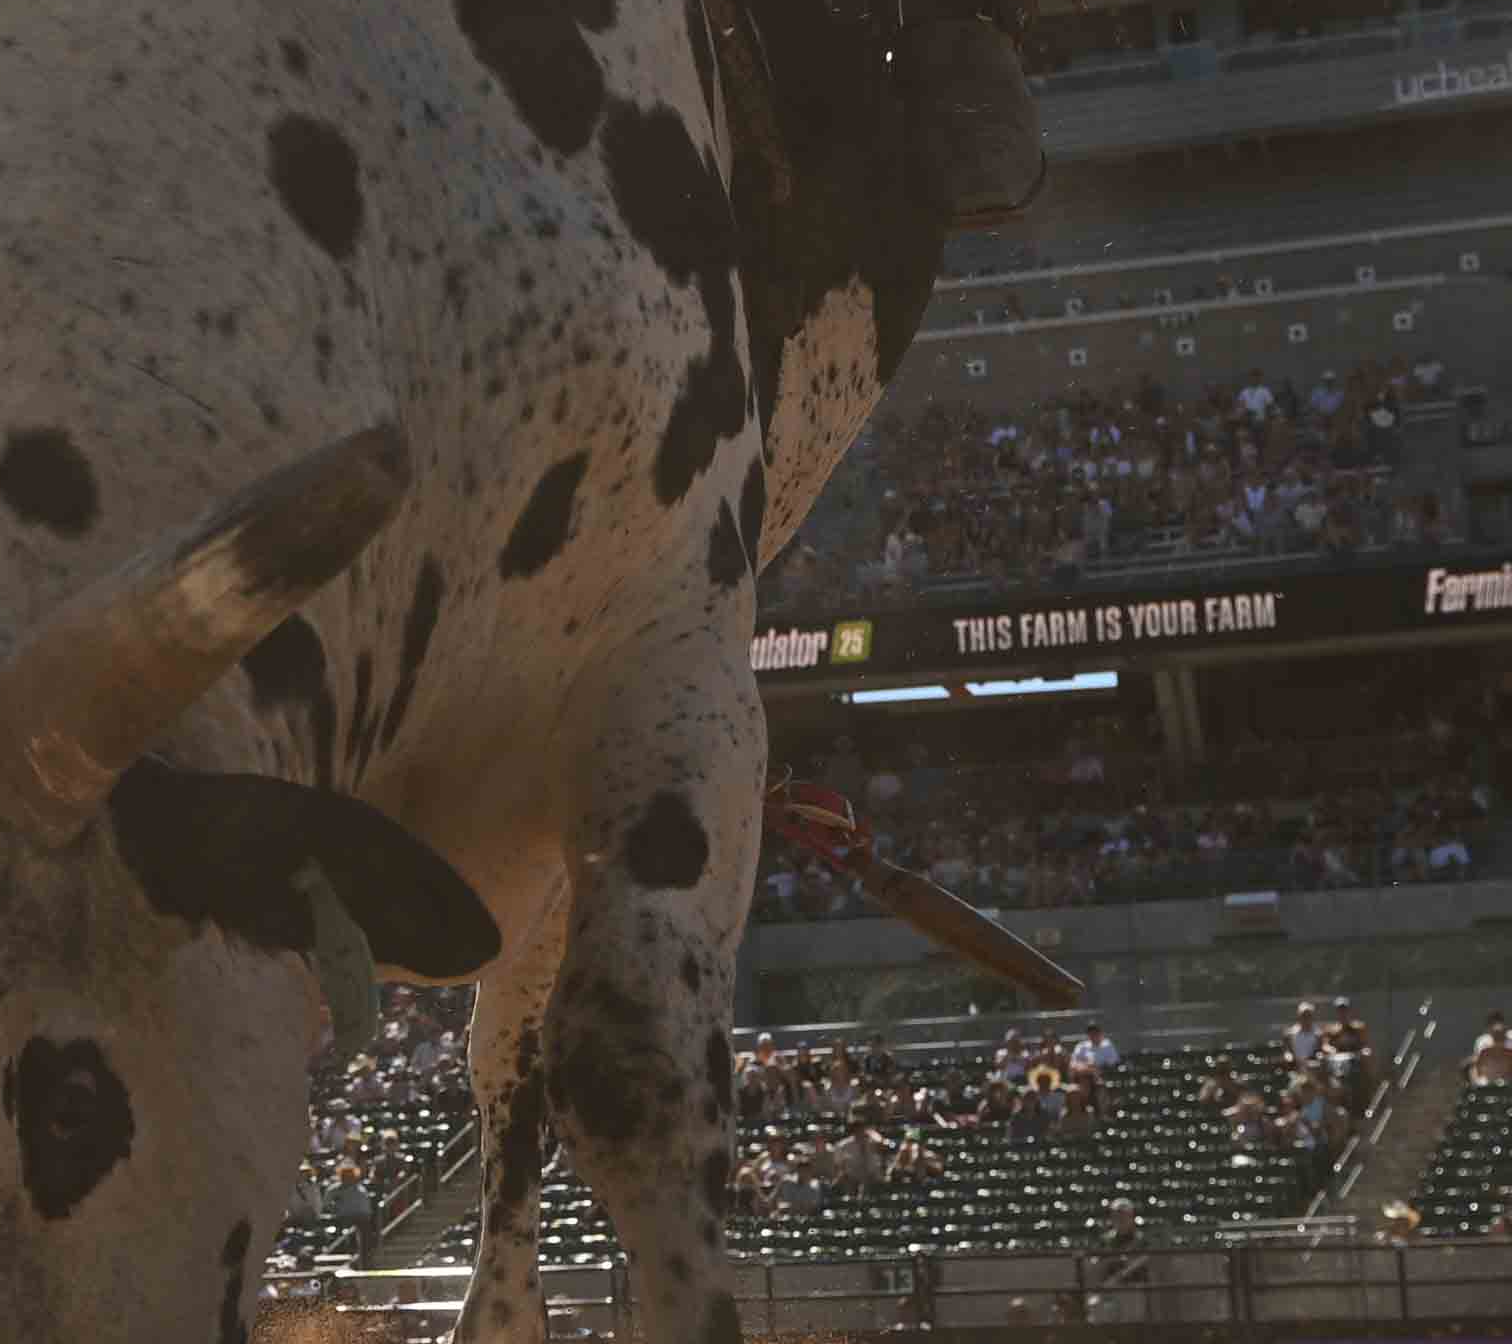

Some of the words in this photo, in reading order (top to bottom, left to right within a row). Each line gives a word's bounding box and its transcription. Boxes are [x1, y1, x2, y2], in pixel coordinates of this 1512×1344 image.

[837, 627, 865, 658] 25
[954, 615, 1013, 654] THIS
[1019, 609, 1088, 650] FARM
[1094, 605, 1123, 644] IS
[1128, 600, 1197, 640] YOUR
[1203, 593, 1277, 633] FARM
